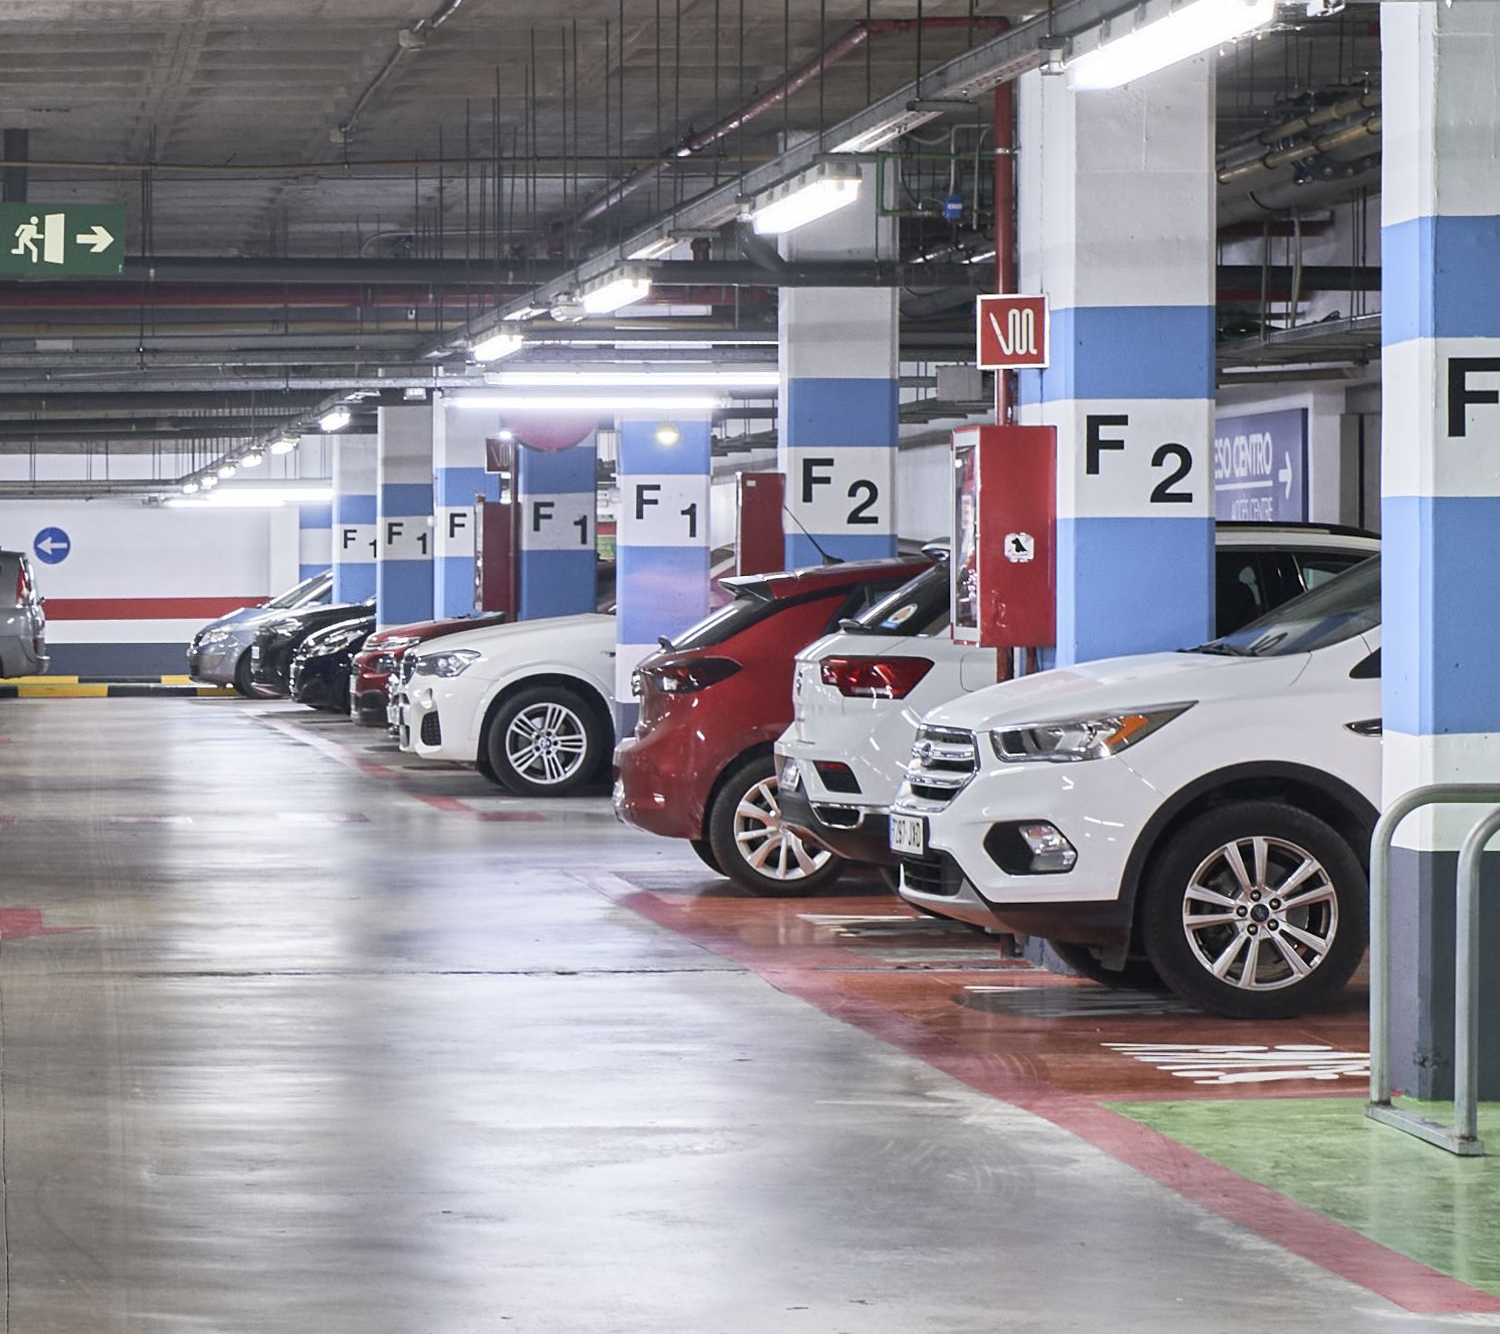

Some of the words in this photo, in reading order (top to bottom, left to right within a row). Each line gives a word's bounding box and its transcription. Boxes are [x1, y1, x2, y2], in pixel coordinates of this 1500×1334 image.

[1086, 414, 1129, 475] F
[1149, 442, 1193, 504] 2
[1232, 431, 1273, 478] CENTRO
[635, 484, 661, 520] F
[680, 502, 697, 538] 1
[802, 457, 835, 503] F
[846, 479, 879, 525] 2
[343, 529, 358, 549] F
[368, 538, 377, 559] 1
[387, 522, 404, 545] F
[416, 532, 427, 555] 1
[449, 512, 468, 539] F
[533, 501, 555, 532] F
[573, 514, 588, 545] 1
